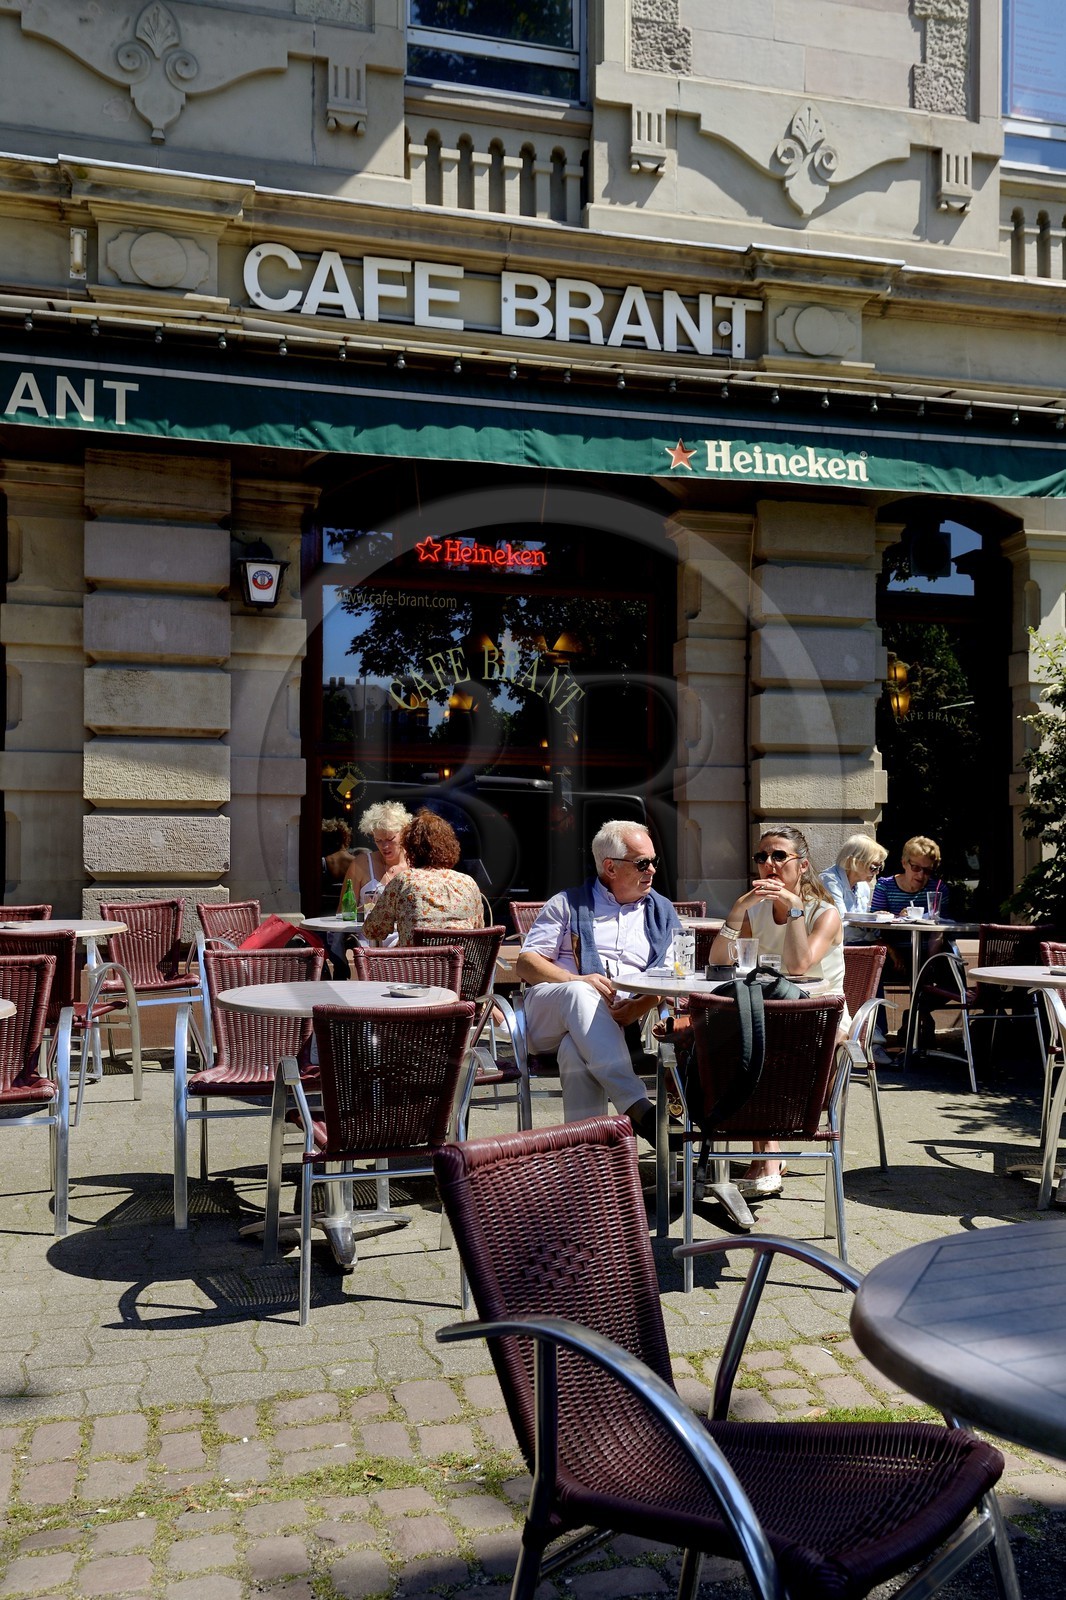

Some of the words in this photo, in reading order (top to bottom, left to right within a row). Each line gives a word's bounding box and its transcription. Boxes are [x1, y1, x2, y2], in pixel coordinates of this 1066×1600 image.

[243, 243, 465, 330] CAFE
[501, 270, 763, 359] BRANT
[4, 372, 139, 425] ANT
[704, 440, 870, 482] Heineken
[444, 540, 548, 566] Heineken
[335, 589, 457, 608] www.cafe-brant.com
[389, 646, 471, 710] CAFE
[482, 644, 586, 714] BRANT
[895, 711, 924, 725] CAFE
